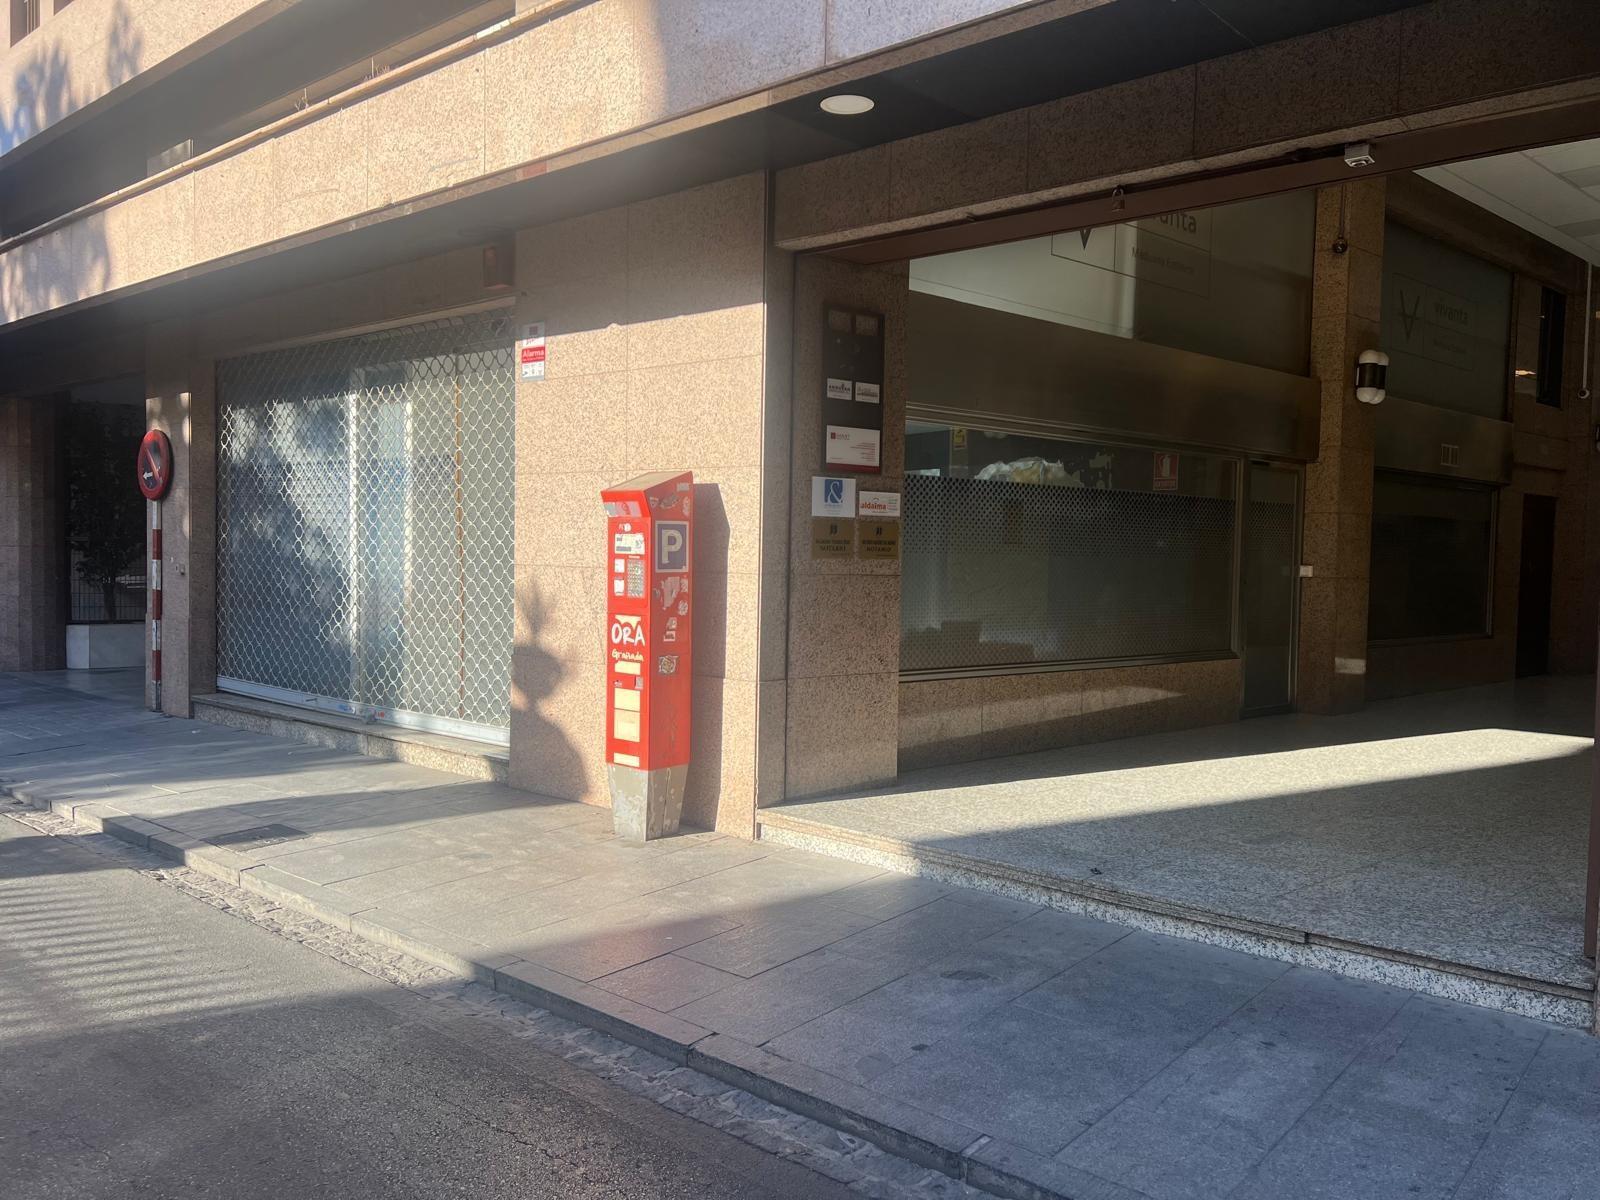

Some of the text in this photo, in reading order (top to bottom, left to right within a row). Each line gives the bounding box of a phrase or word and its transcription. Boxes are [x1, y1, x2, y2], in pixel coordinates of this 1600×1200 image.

[523, 349, 545, 358] Alarma
[661, 529, 683, 564] P
[611, 623, 645, 647] ORA
[611, 648, 644, 662] Granada
